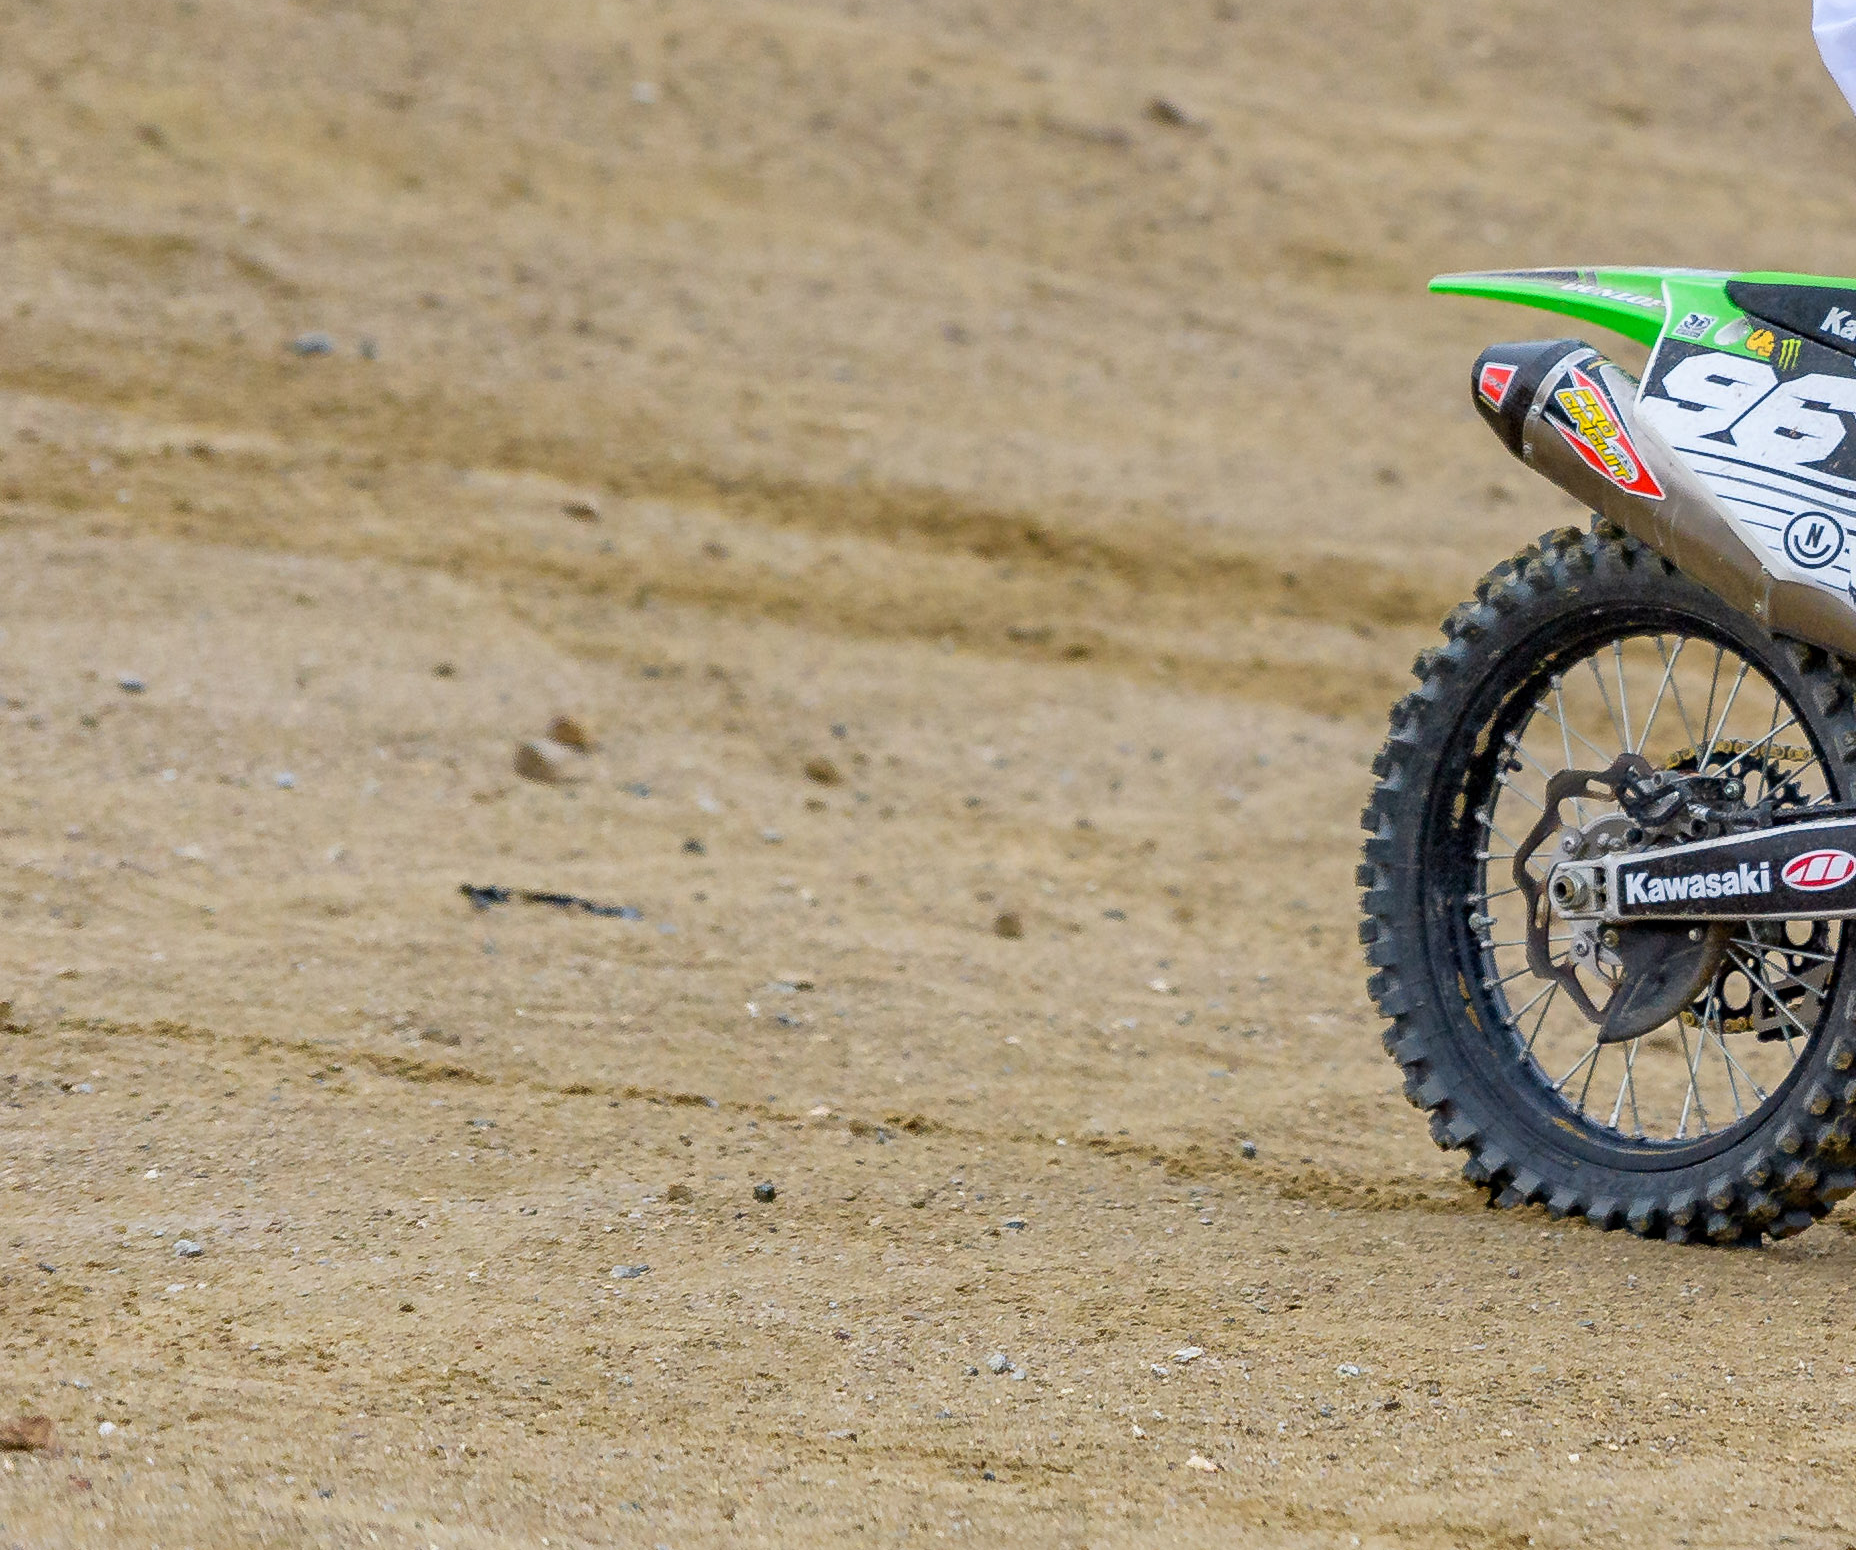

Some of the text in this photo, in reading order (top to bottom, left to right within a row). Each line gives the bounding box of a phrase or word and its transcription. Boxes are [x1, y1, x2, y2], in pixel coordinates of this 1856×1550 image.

[1557, 391, 1632, 482] CIRCUIT
[1575, 389, 1619, 438] PRO
[1625, 861, 1772, 905] Kawasaki
